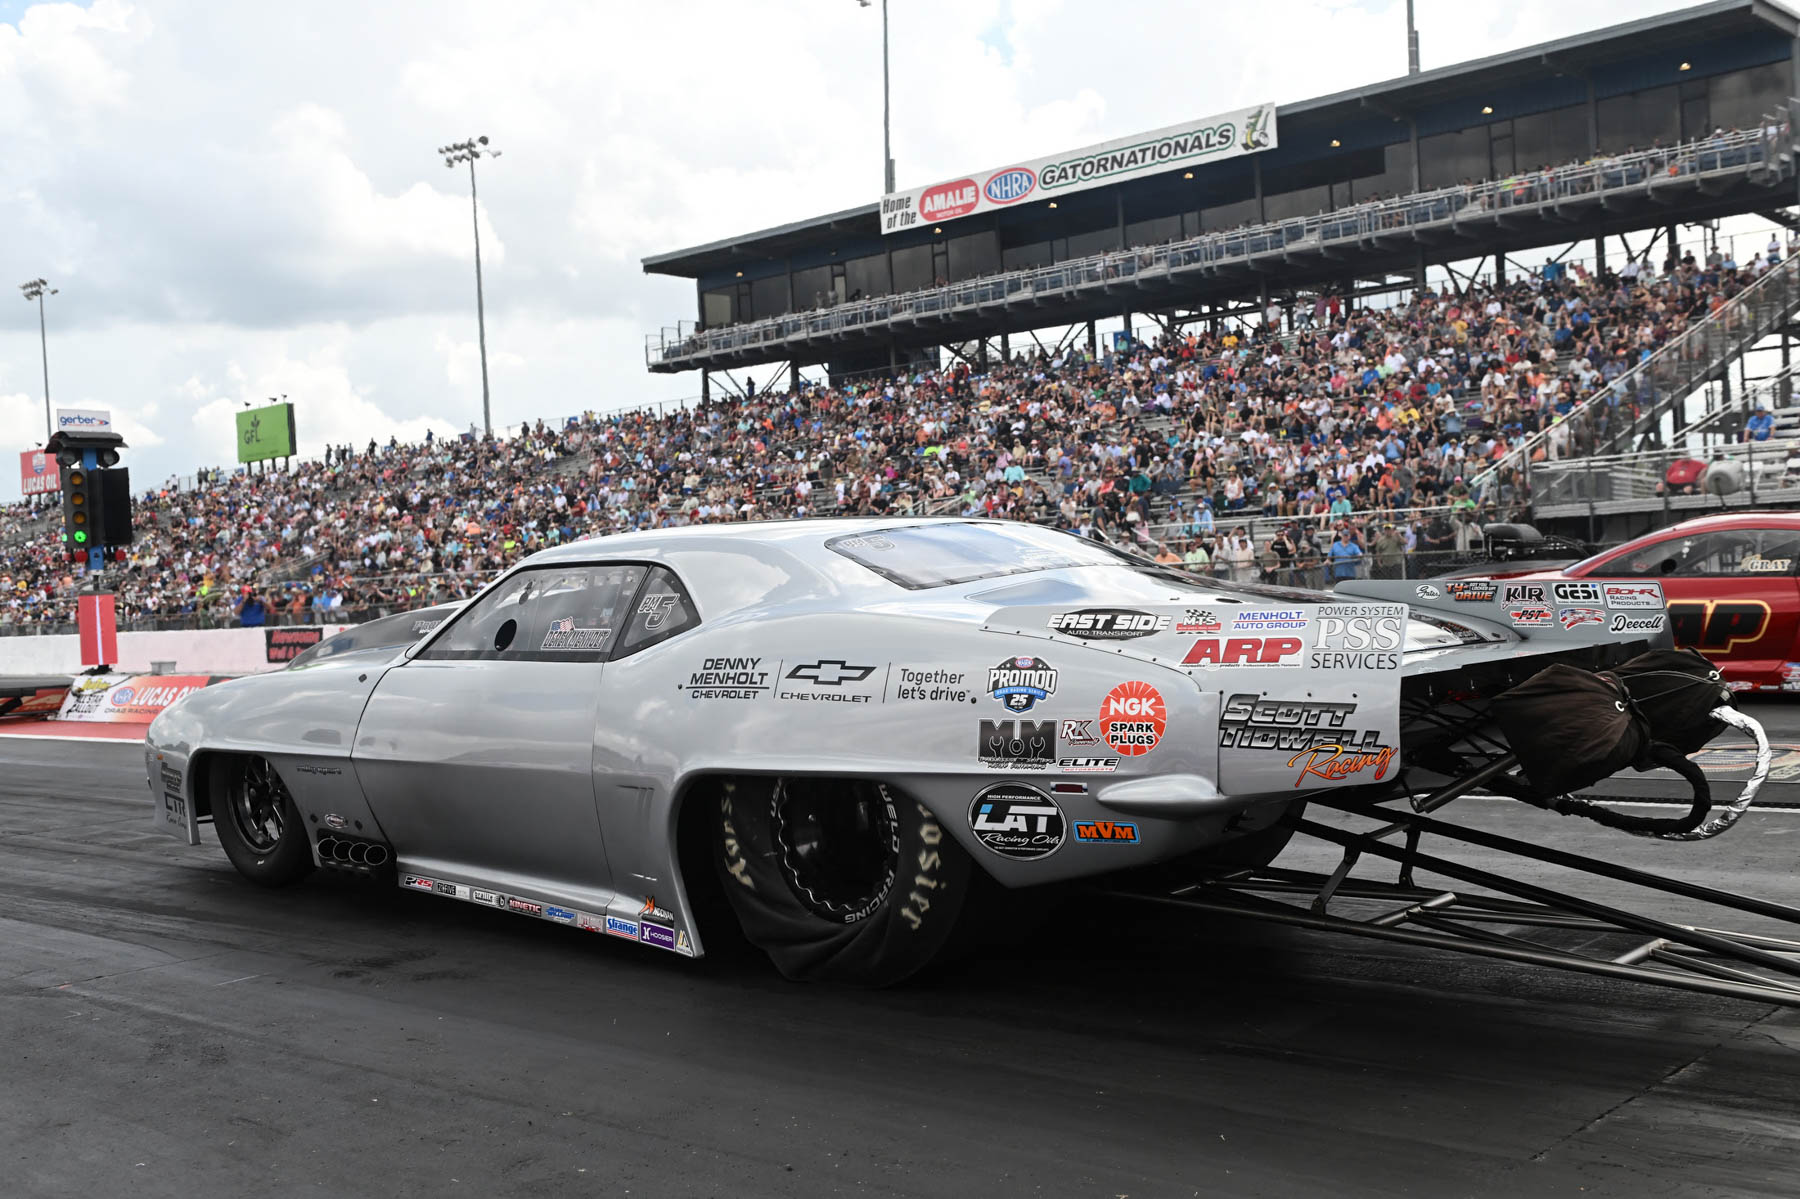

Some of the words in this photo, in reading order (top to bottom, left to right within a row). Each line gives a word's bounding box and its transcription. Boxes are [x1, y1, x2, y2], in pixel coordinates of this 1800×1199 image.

[1042, 127, 1231, 186] GATORNATIONALS
[991, 172, 1030, 199] NHRA
[882, 196, 911, 214] Home
[923, 186, 977, 214] AMALIE
[887, 214, 898, 229] of
[900, 211, 917, 227] the
[60, 414, 96, 426] gerber
[23, 477, 45, 493] LUCAS
[46, 474, 57, 489] OIL
[1749, 559, 1792, 571] GRAY
[646, 594, 680, 629] 5
[1238, 612, 1304, 621] MENHOLT
[1318, 606, 1359, 616] POWER
[1361, 606, 1404, 616] SYSTEM
[1519, 610, 1544, 620] PST
[1047, 614, 1113, 629] EAST
[1113, 615, 1172, 630] SIDE
[1233, 622, 1264, 630] AUTO
[1266, 622, 1307, 630] GROUP
[1611, 615, 1664, 631] Deecell
[1311, 616, 1402, 651] PSS
[1180, 637, 1302, 664] ARP
[703, 657, 762, 671] DENNY
[1310, 653, 1398, 670] SERVICES
[690, 672, 769, 686] MENHOLT
[900, 668, 964, 686] Together
[131, 686, 178, 706] LUCAS
[691, 690, 759, 700] CHEVROLET
[780, 692, 872, 703] CHEVROLET
[897, 684, 926, 700] let's
[1009, 694, 1029, 706] 25
[1109, 697, 1157, 716] NGK
[1221, 694, 1357, 727] SCOTT
[1060, 720, 1093, 740] RK
[1110, 722, 1154, 733] SPARK
[1110, 734, 1154, 745] PLUGS
[1219, 721, 1389, 754] TIDWELL
[1058, 758, 1119, 767] ELITE
[1287, 744, 1398, 788] Racing
[878, 784, 900, 853] WELD
[973, 803, 1058, 833] LAT
[1078, 821, 1135, 840] MVM
[981, 833, 1030, 846] Racing
[1031, 834, 1060, 844] Oils
[844, 869, 896, 923] RACING
[509, 899, 541, 913] KINETIC
[607, 918, 638, 935] Strange
[650, 931, 673, 942] HOOSIER
